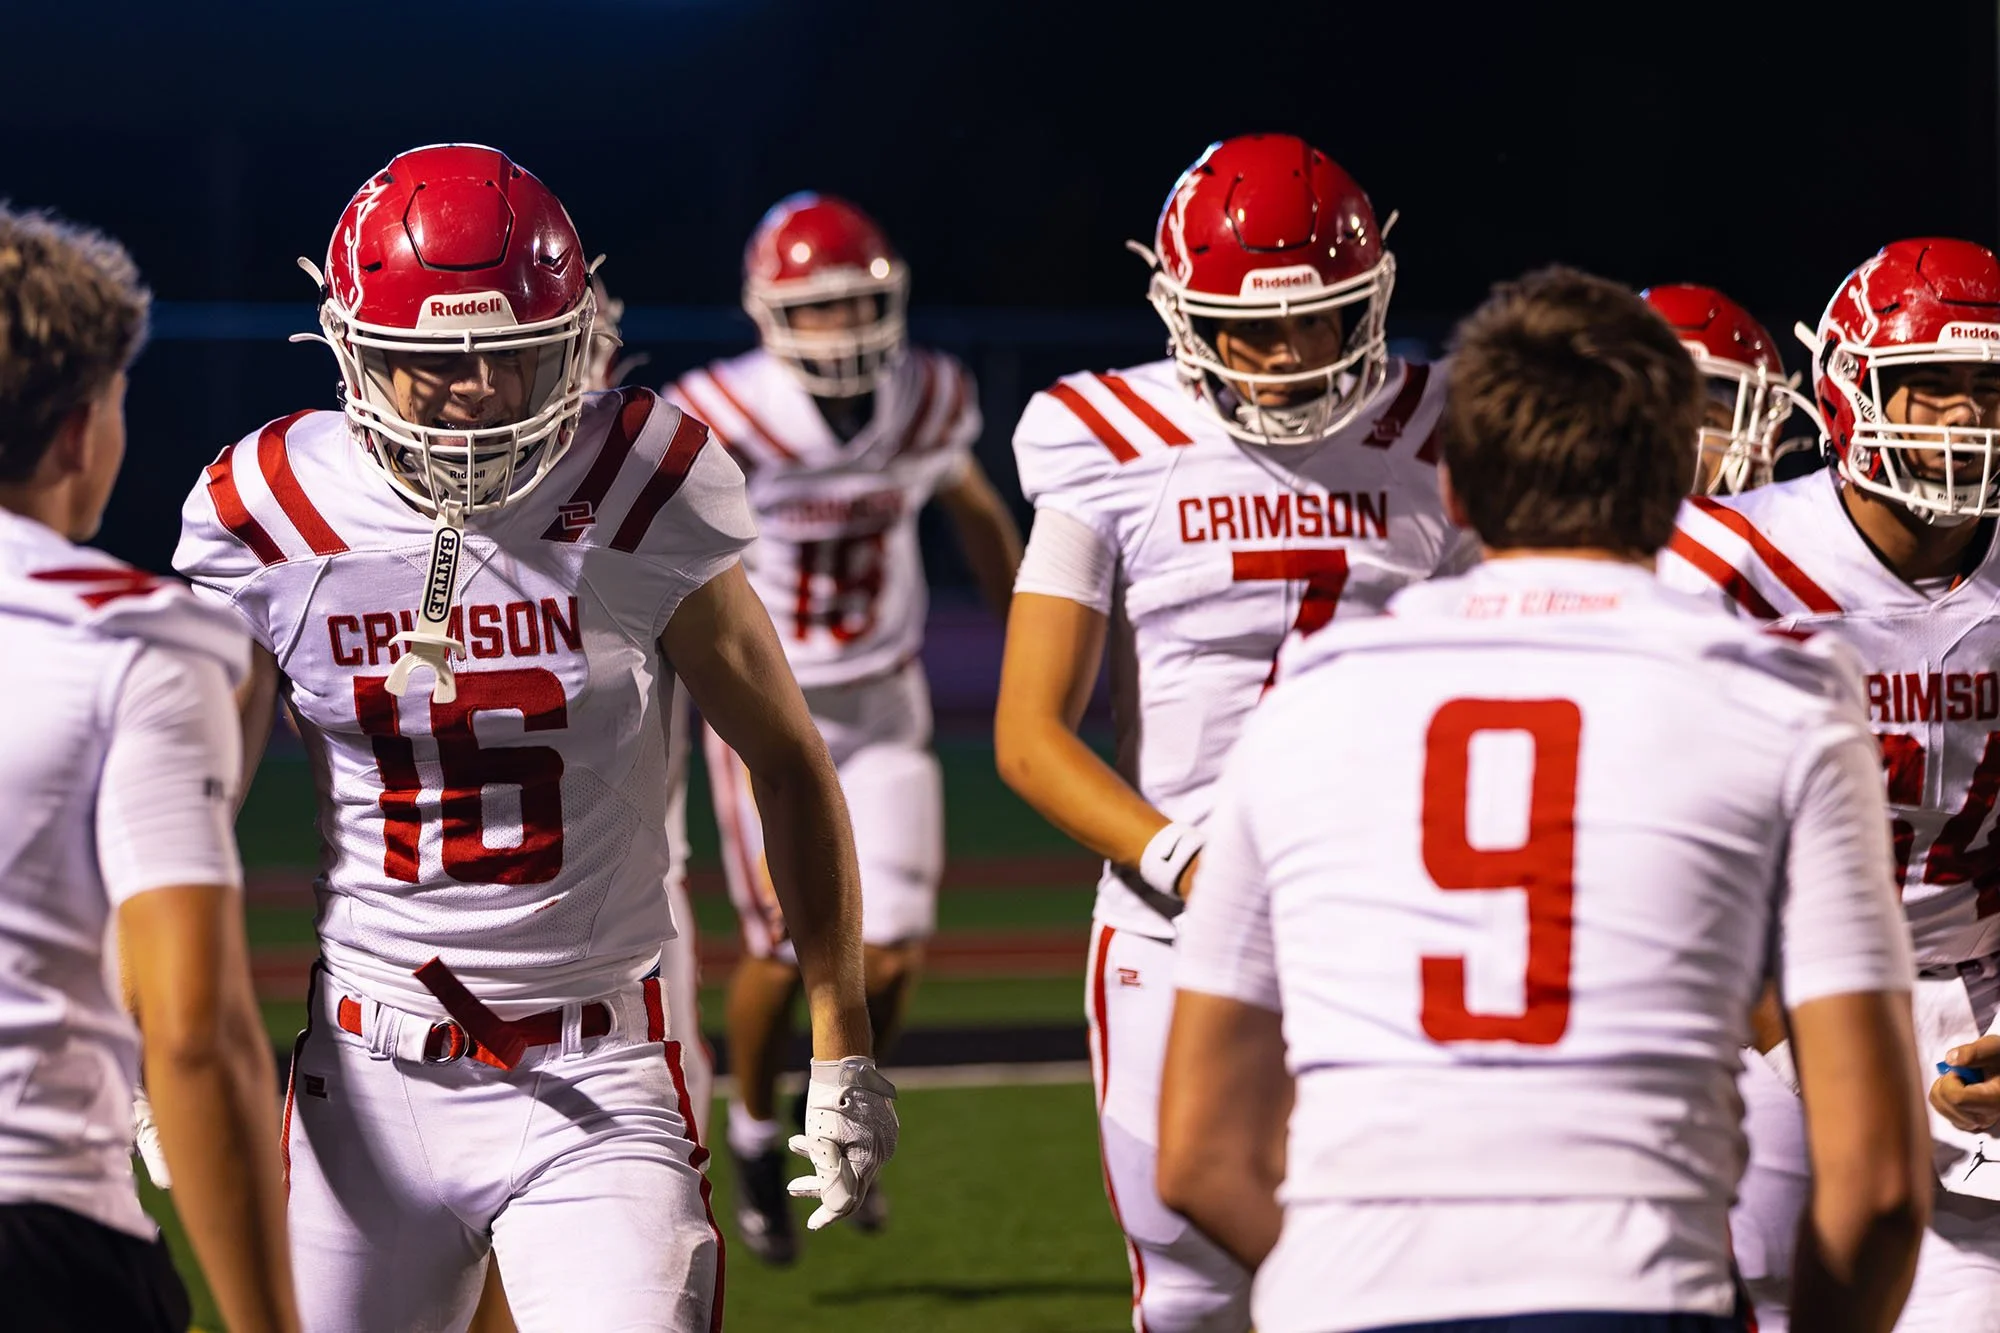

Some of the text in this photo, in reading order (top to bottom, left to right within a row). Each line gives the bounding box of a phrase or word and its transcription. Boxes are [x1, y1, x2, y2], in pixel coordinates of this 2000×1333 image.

[1252, 271, 1313, 289] Riddell
[430, 298, 502, 317] Riddell
[1950, 326, 2000, 340] Ridde
[450, 469, 486, 479] Ridell
[1178, 492, 1389, 543] CRIMSON
[429, 535, 456, 615] BATTLE
[1232, 547, 1350, 690] 7
[1866, 671, 2000, 723] RIMSO
[353, 667, 568, 886] 16
[1420, 697, 1582, 1046] 9
